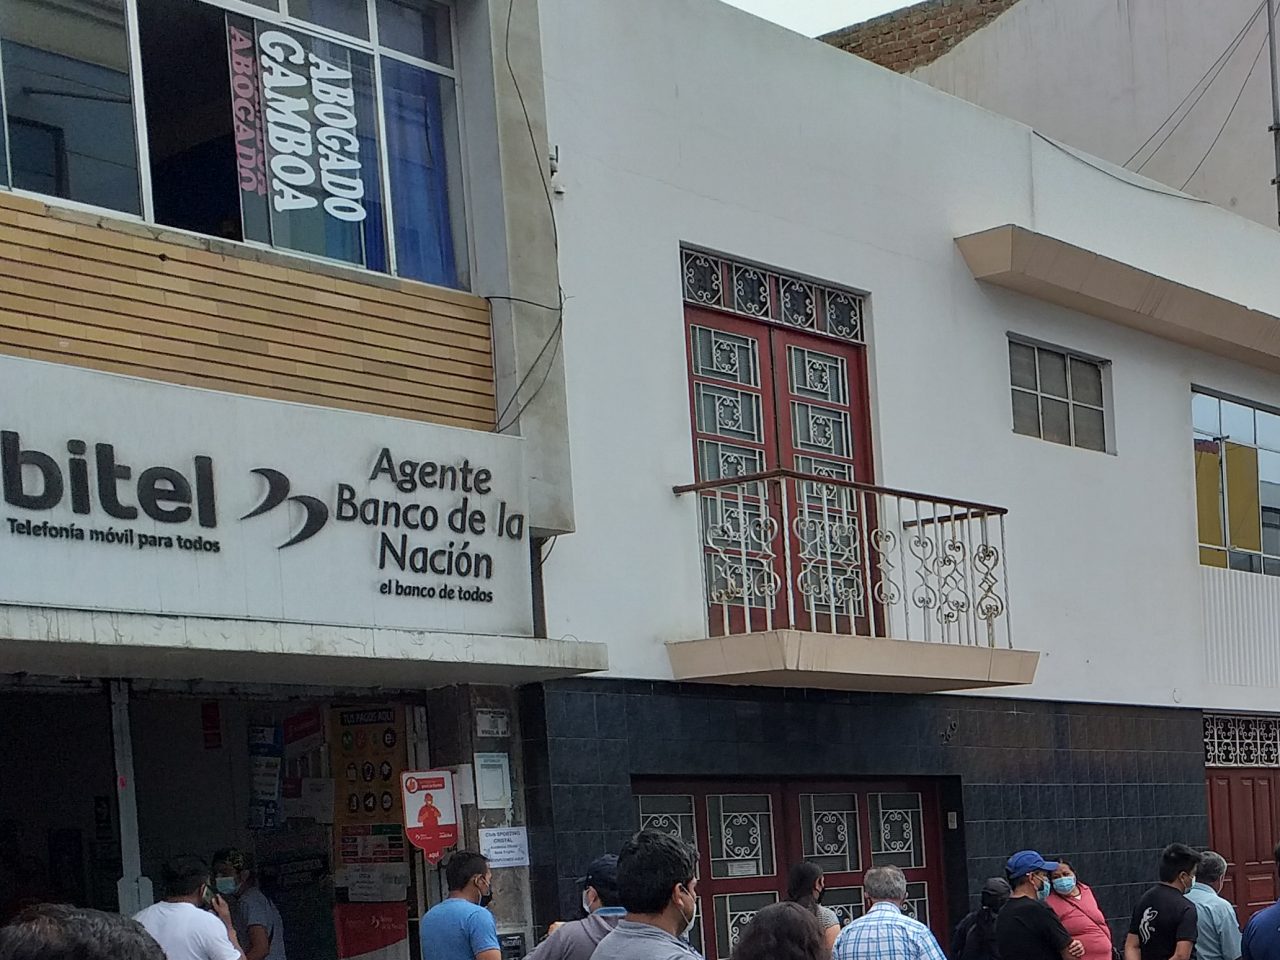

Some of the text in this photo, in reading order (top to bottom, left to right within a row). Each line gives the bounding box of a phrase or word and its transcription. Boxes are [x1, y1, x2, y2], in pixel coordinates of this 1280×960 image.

[230, 26, 258, 192] ABOGADO
[259, 30, 318, 212] GAMBOA
[308, 53, 367, 222] ABOGADO
[1, 430, 218, 528] bitel
[369, 447, 492, 495] Agente
[7, 517, 221, 553] Telefonía móvil para todos
[336, 483, 525, 540] Banco de la
[379, 531, 493, 579] Nación
[380, 578, 493, 602] el banco de todos
